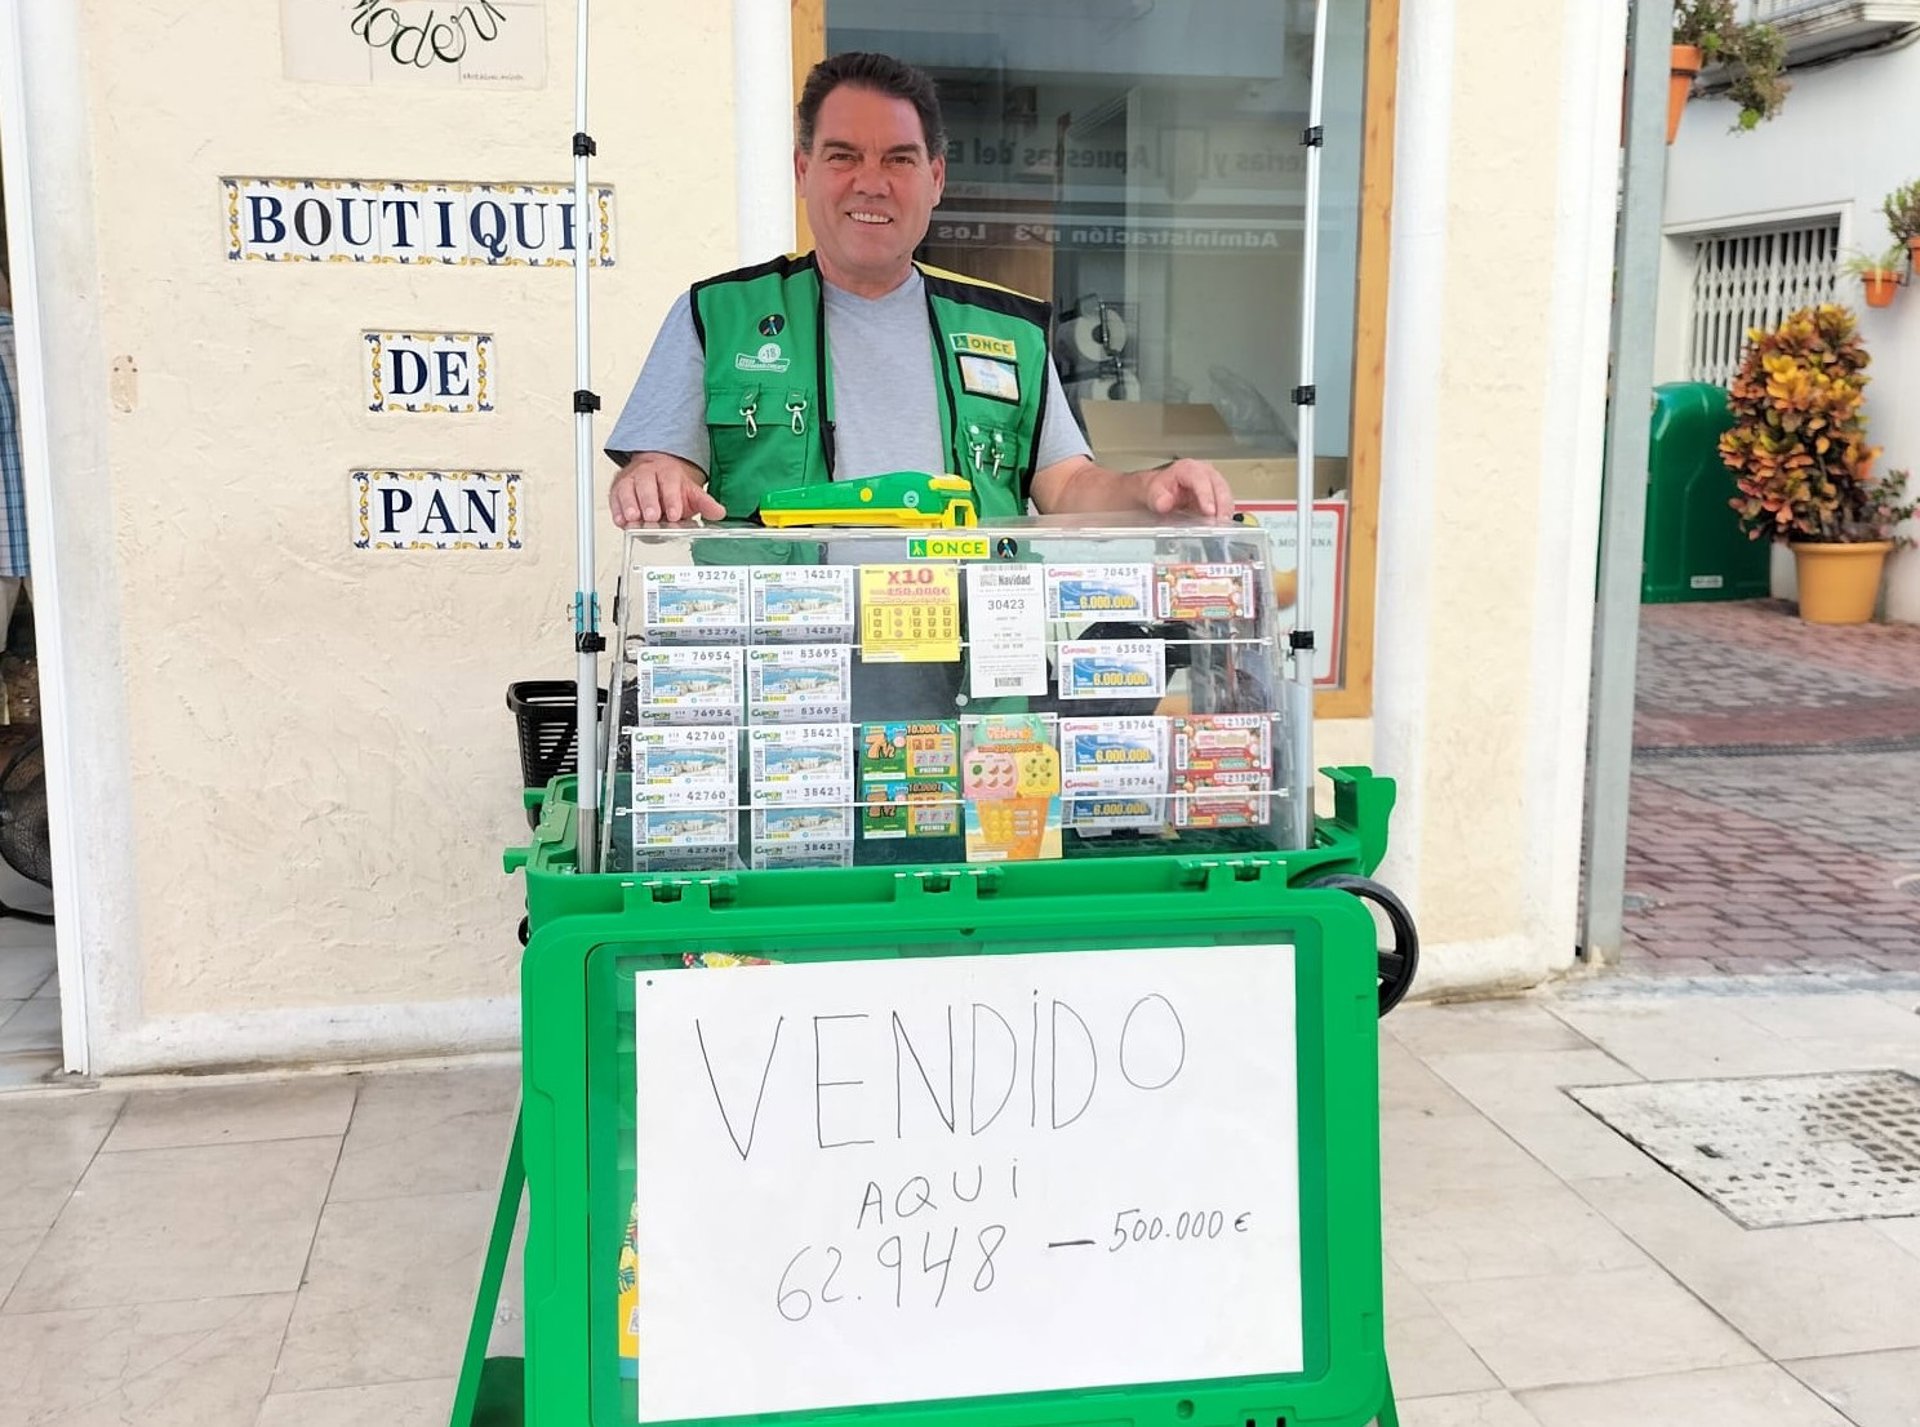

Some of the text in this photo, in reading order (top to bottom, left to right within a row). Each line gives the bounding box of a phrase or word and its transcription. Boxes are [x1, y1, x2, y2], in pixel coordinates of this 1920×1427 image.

[971, 338, 1012, 356] ONCE
[387, 348, 470, 397] DE
[377, 488, 501, 534] PAN
[932, 542, 984, 555] ONCE
[697, 570, 737, 581] 93276
[803, 569, 841, 580] 14287
[887, 567, 935, 586] x10
[987, 599, 1026, 610] 30423
[1115, 643, 1152, 654] 63502
[692, 650, 731, 661] 76954
[692, 708, 732, 718] 76954
[685, 731, 725, 742] 42760
[686, 790, 727, 801] 42760
[777, 1225, 1006, 1322] 62.948
